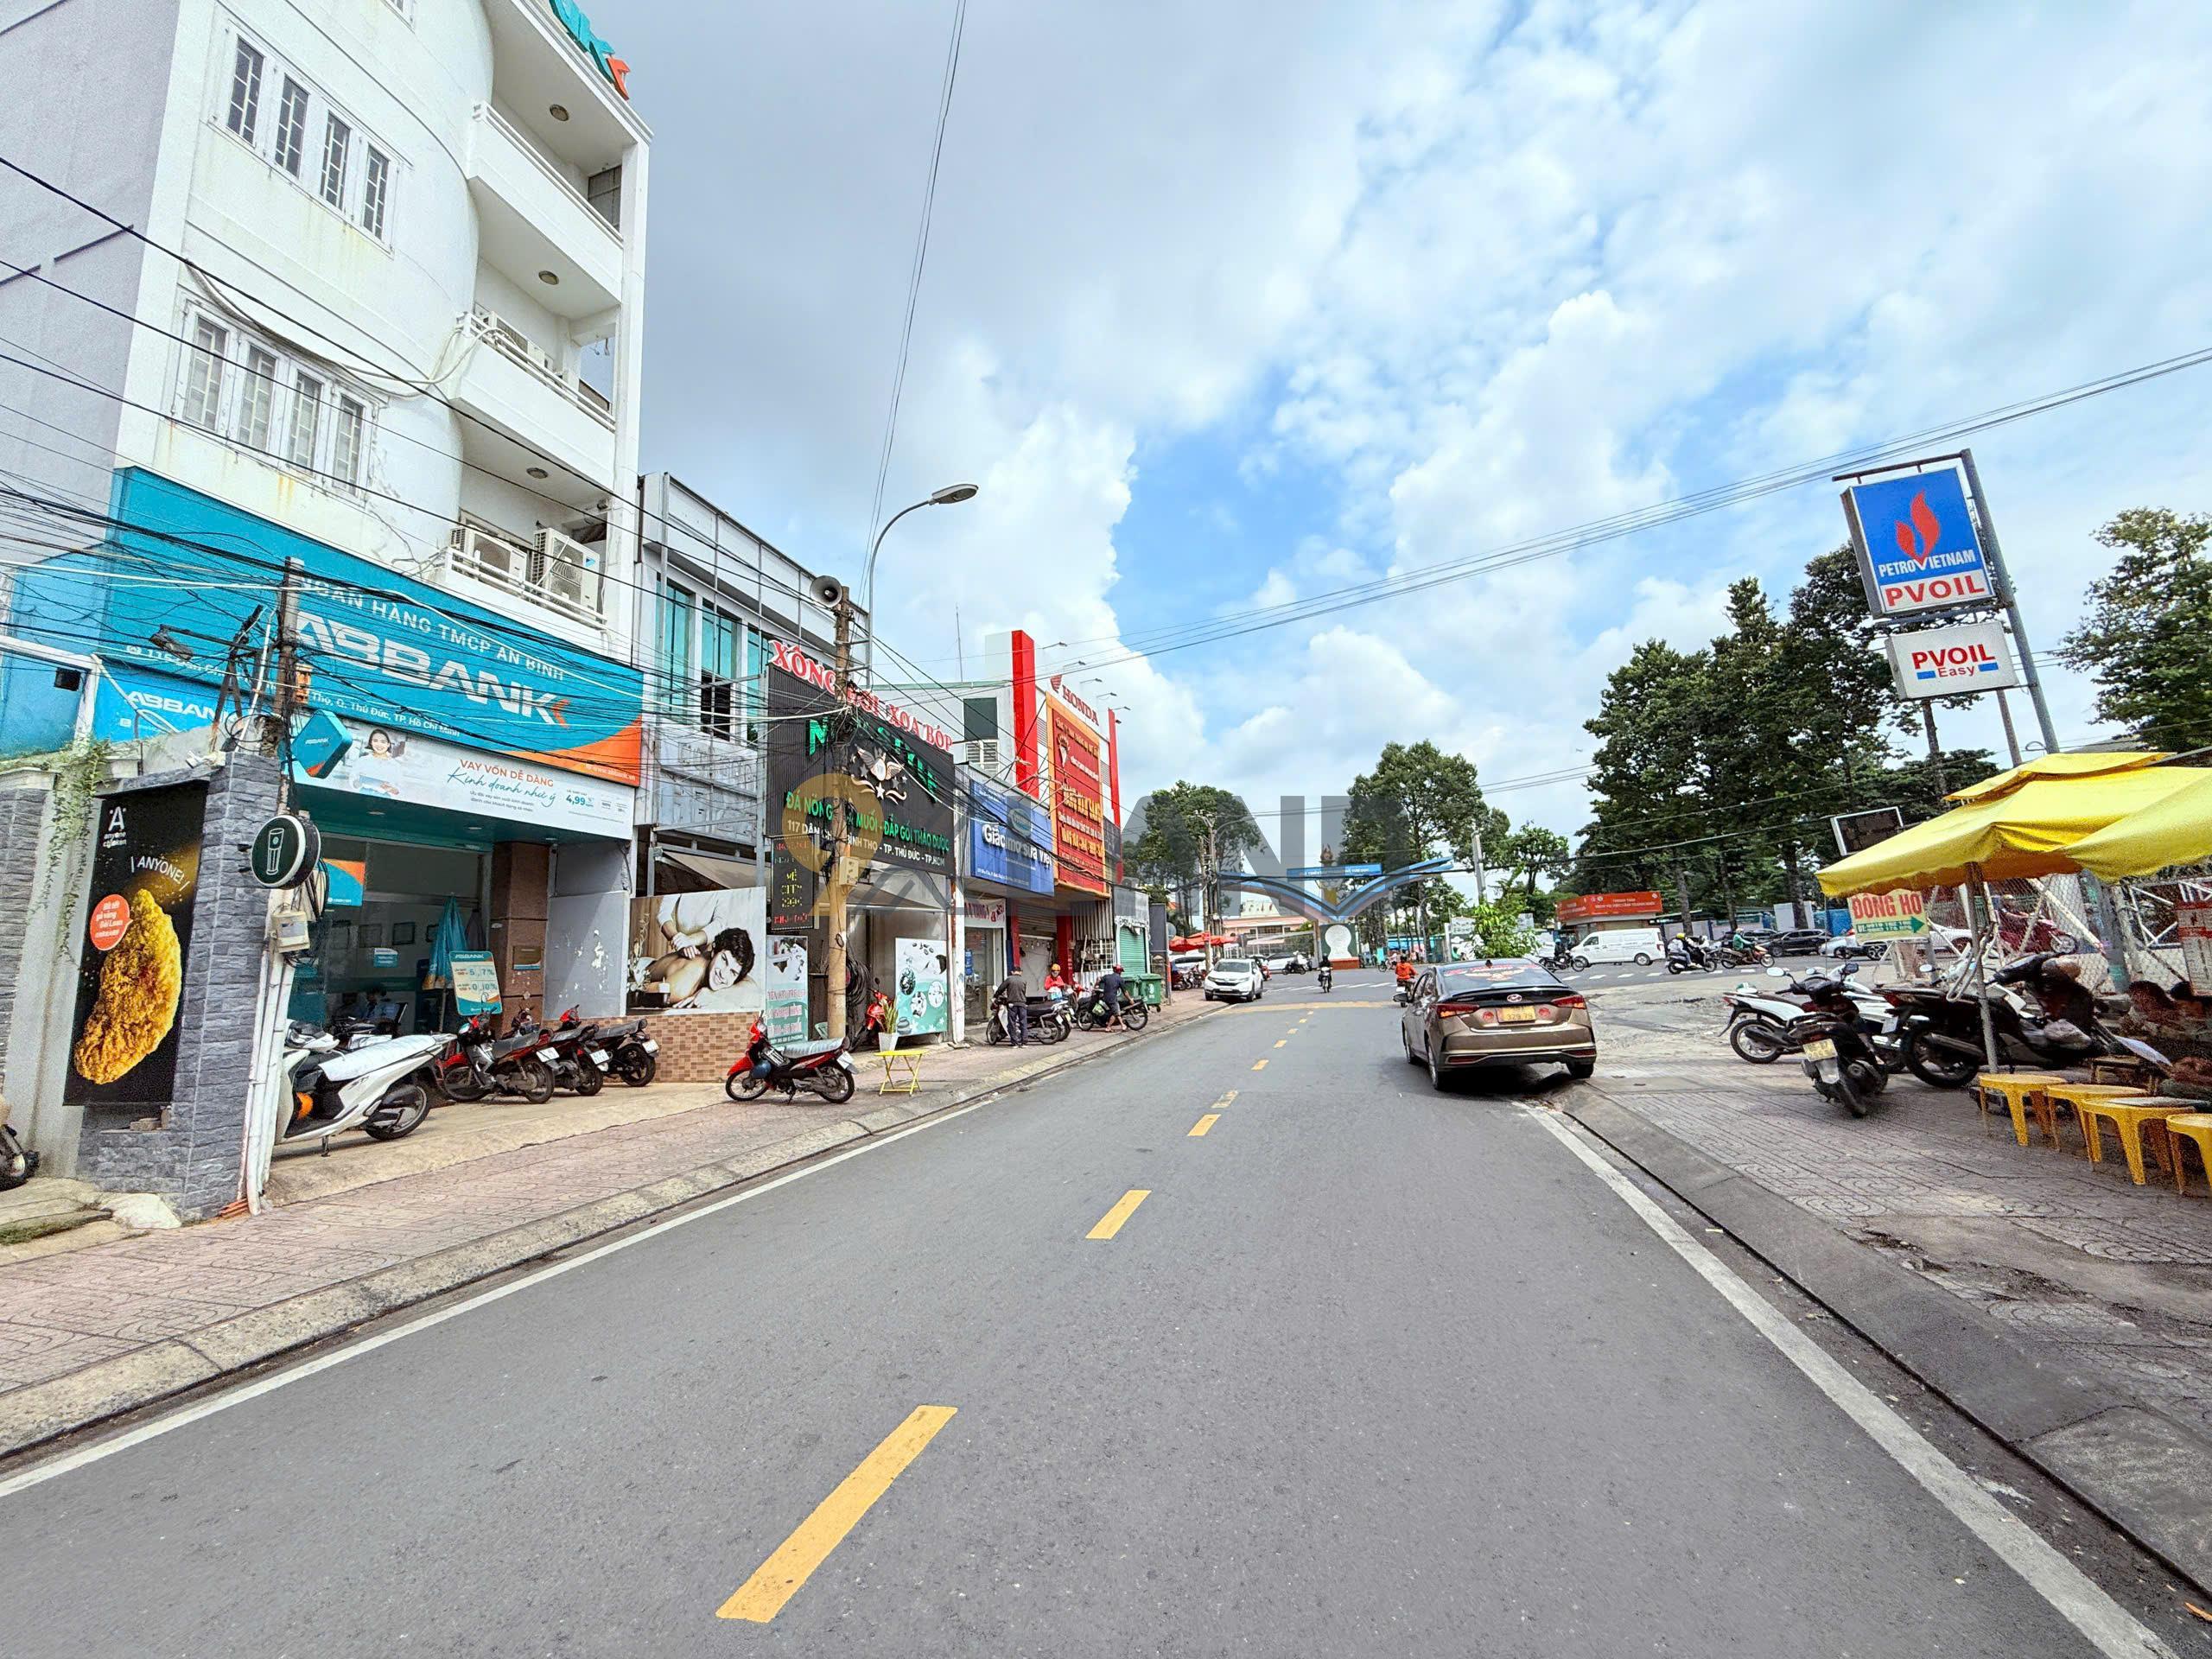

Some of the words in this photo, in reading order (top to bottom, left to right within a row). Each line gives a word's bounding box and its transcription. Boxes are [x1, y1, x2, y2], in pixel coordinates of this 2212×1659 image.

[1878, 549, 1976, 578] PETROVIETNAM
[1885, 575, 1986, 607] PVOIL
[372, 603, 431, 632] HÀNG
[439, 624, 491, 654] TMCP
[496, 649, 520, 665] AN
[297, 611, 570, 728] ABBANK
[1911, 644, 1997, 671] PVOIL
[1938, 664, 1975, 678] Easy
[1062, 684, 1100, 727] HONDA
[888, 703, 922, 741] XOA
[924, 724, 954, 752] BÓP
[447, 766, 486, 786] Kinh
[488, 777, 522, 794] doanh
[460, 760, 483, 772] VAY
[526, 772, 554, 787] DÀNG
[566, 794, 587, 806] 4,99
[787, 819, 801, 833] 117
[802, 822, 820, 836] DÂN
[894, 845, 907, 858] THỦ
[907, 848, 921, 861] ĐỨC
[137, 855, 185, 885] ANYONE!
